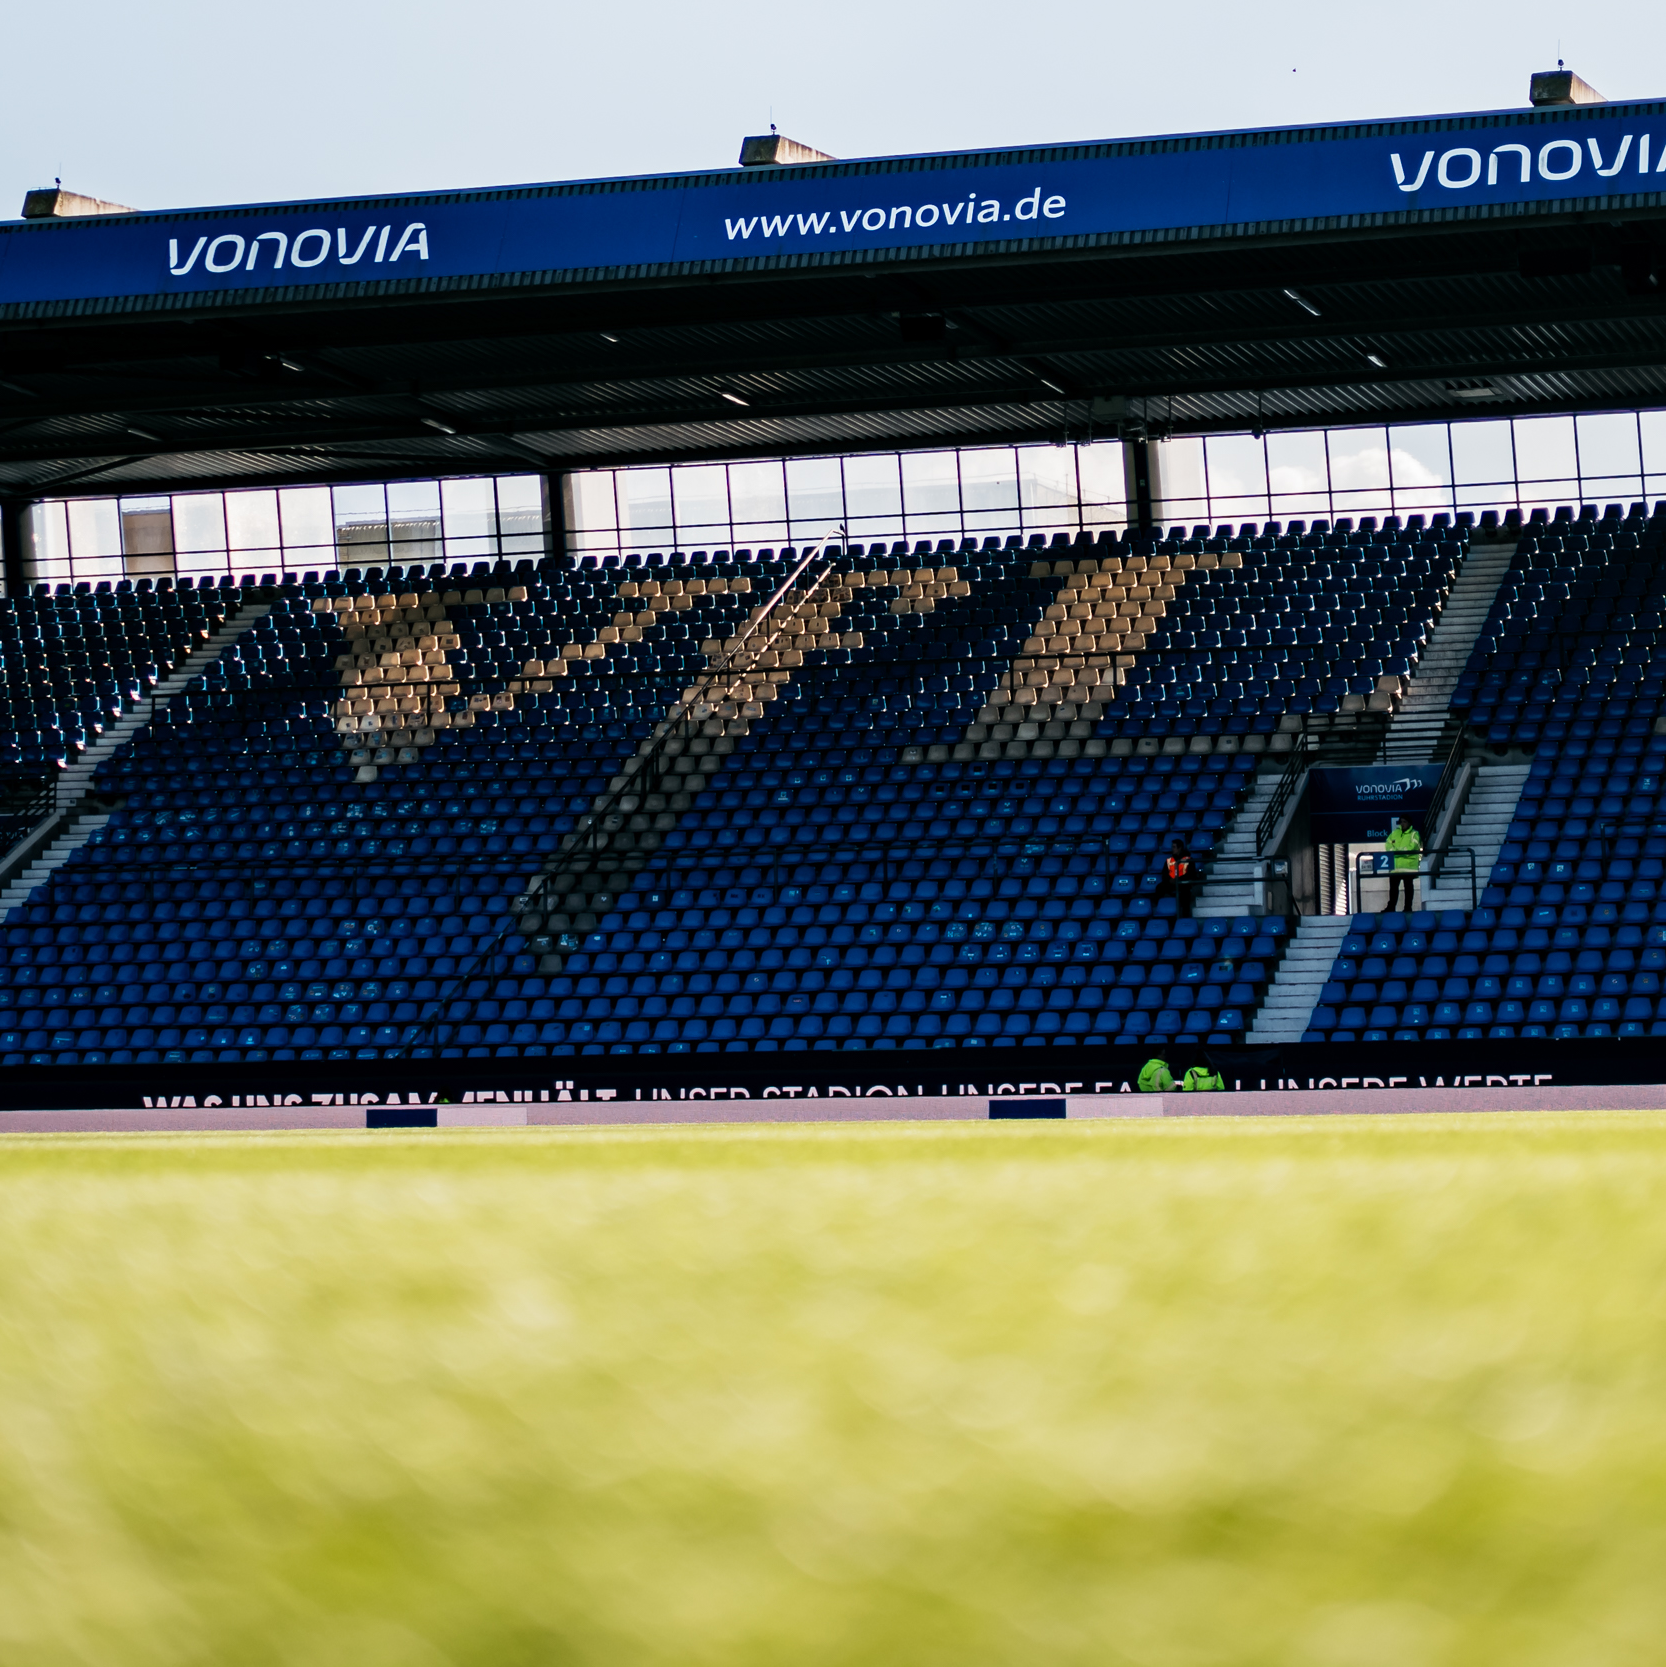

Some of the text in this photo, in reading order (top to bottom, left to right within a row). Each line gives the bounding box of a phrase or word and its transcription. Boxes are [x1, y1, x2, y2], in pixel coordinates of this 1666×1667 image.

[724, 186, 1066, 241] www.vonovia.de
[169, 222, 429, 276] VONOVIA
[1355, 784, 1402, 793] VONOVIA
[1367, 829, 1388, 838] Block
[1380, 855, 1388, 867] 2
